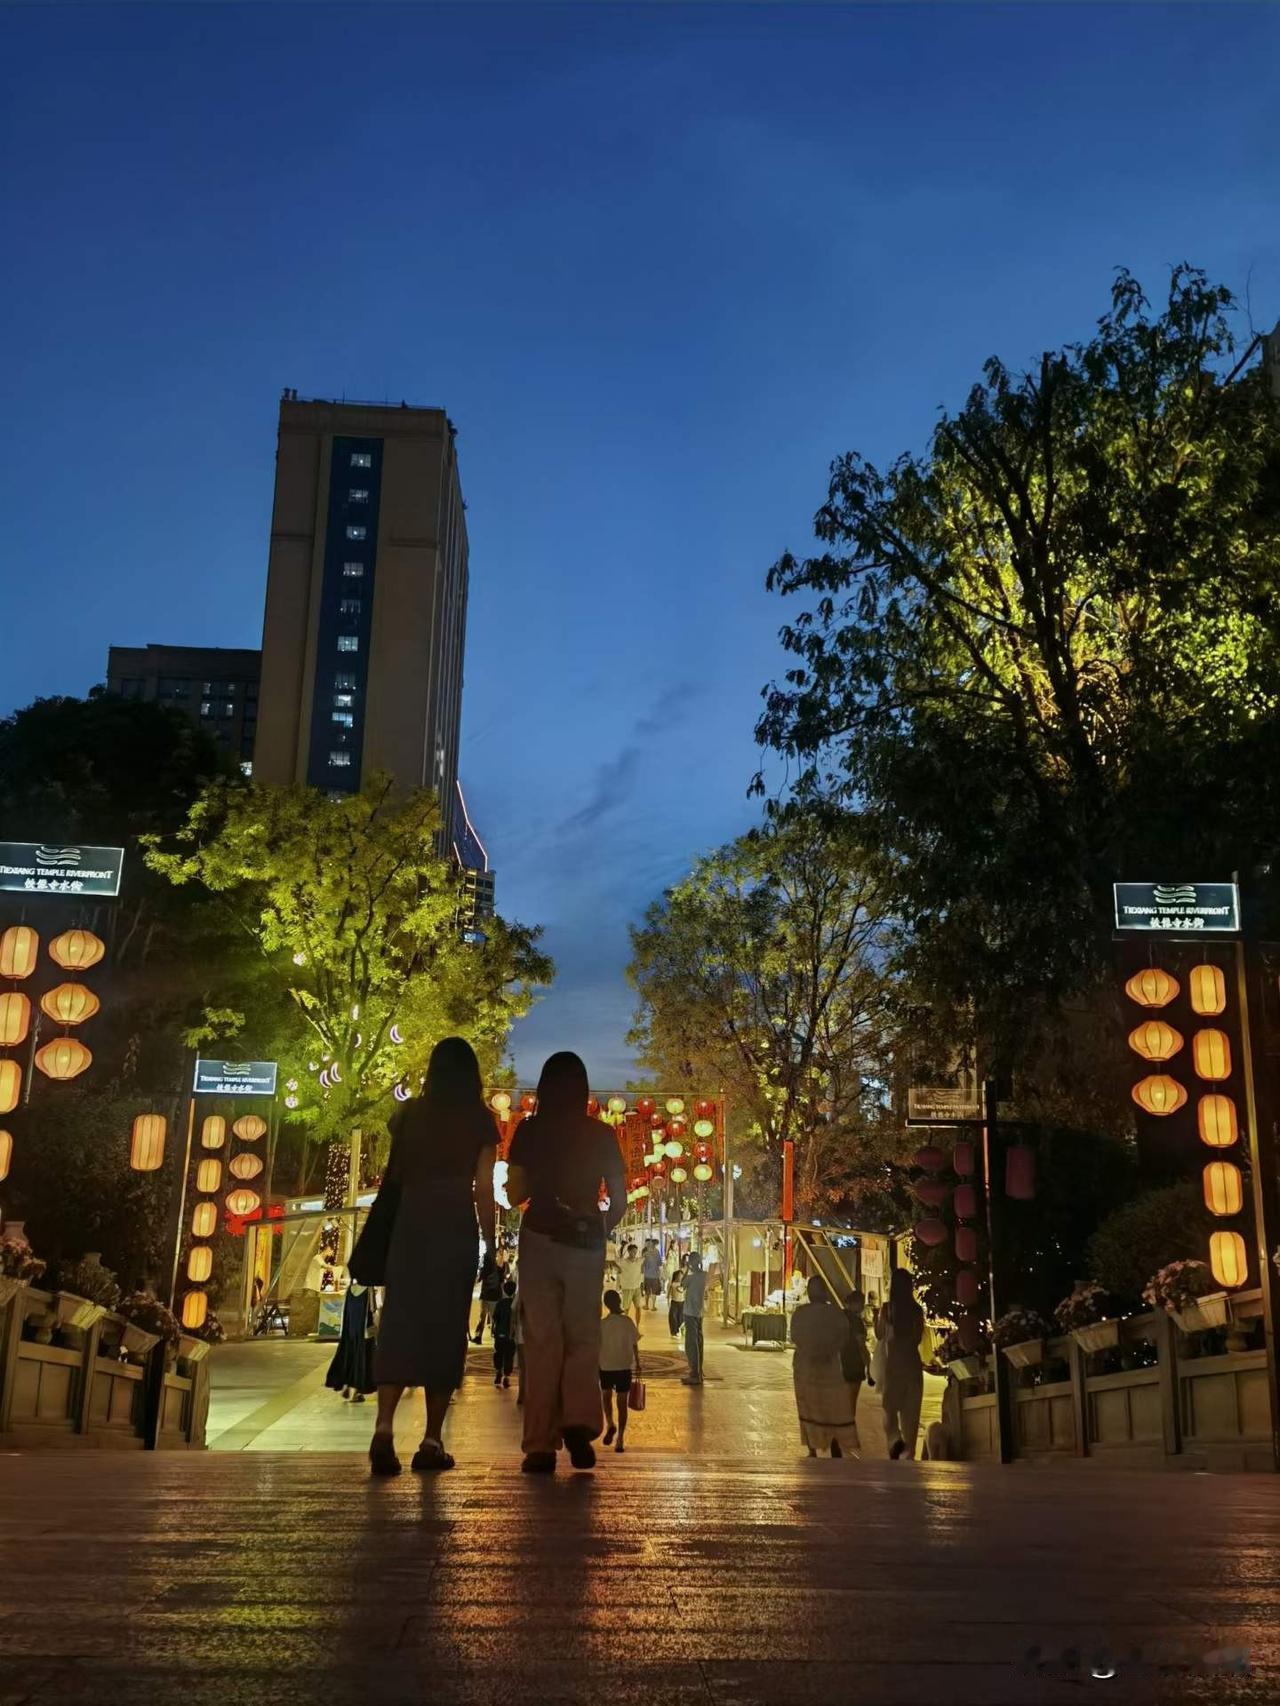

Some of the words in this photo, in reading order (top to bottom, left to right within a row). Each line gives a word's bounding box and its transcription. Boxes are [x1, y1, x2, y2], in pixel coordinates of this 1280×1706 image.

[37, 868, 65, 877] TEMPLE
[66, 869, 114, 879] RIVERFRONT
[1158, 906, 1185, 914] TEMPLE
[1186, 906, 1230, 915] RIVERFRONT
